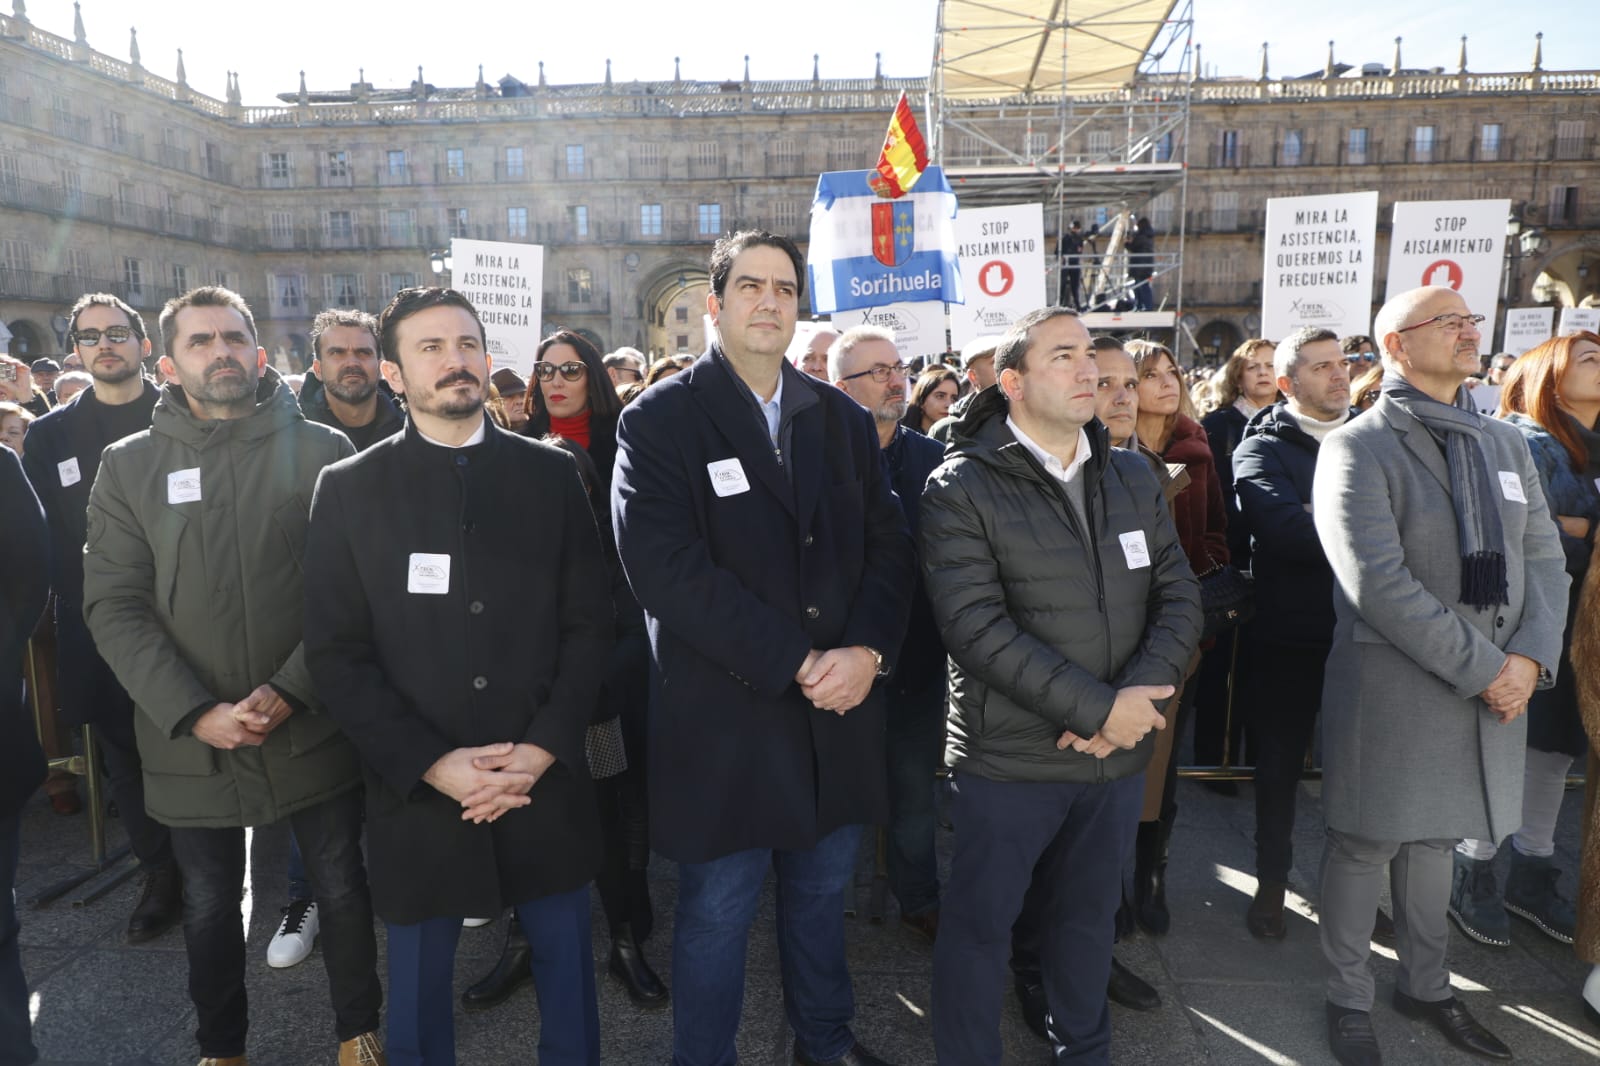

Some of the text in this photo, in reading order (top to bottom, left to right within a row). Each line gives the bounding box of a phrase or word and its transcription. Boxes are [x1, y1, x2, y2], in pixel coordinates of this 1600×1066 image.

[1296, 208, 1348, 225] MIRA LA
[1434, 216, 1468, 232] STOP
[982, 221, 1009, 236] STOP
[1281, 229, 1361, 247] ASISTENCIA,
[1403, 238, 1493, 255] AISLAMIENTO
[958, 239, 1035, 258] AISLAMIENTO
[475, 253, 520, 270] MIRA LA
[1277, 249, 1362, 268] QUEREMOS LA
[463, 272, 531, 291] ASISTENCIA,
[850, 269, 942, 297] Sorihuela
[1279, 270, 1358, 288] FRECUENCIA
[521, 295, 532, 309] LA
[477, 311, 529, 327] ECUENCIA
